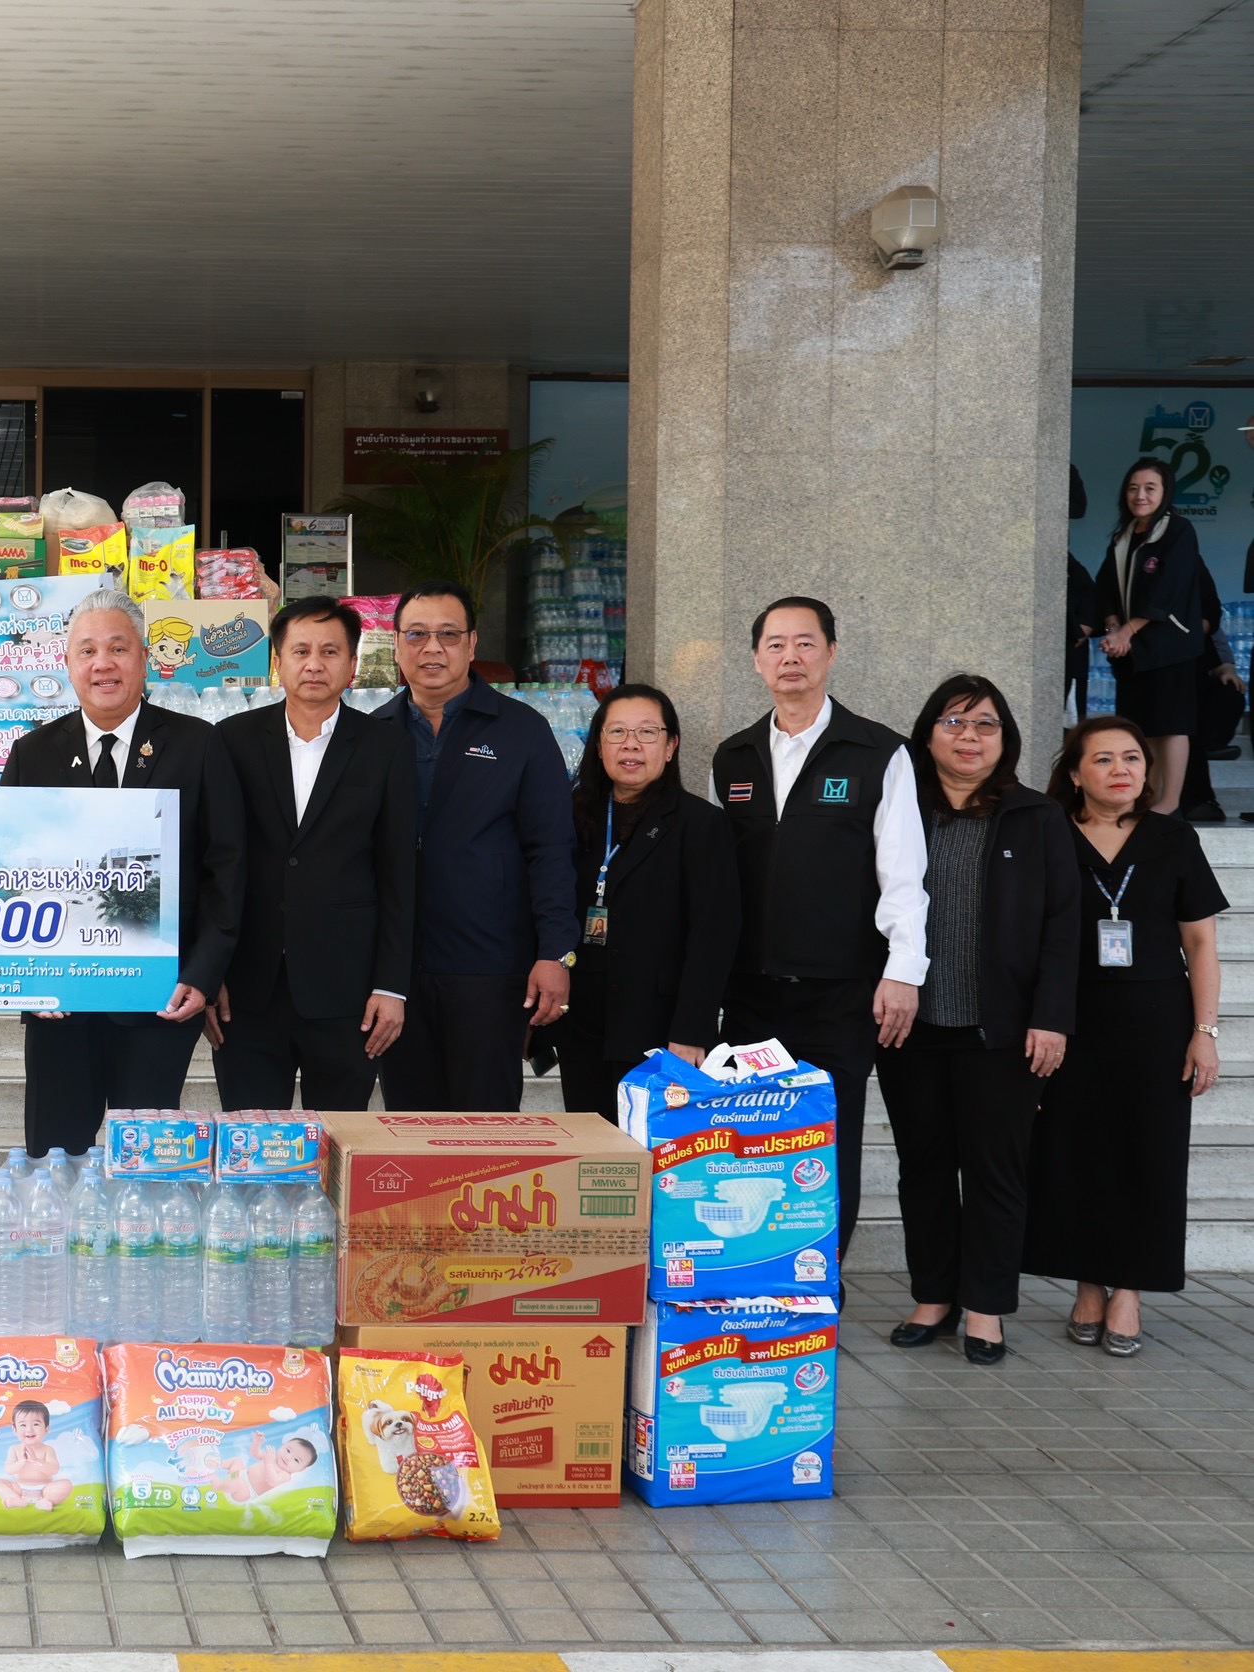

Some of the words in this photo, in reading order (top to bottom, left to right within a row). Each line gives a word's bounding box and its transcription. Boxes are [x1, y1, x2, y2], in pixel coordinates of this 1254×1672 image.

[80, 926, 121, 944] บาท
[68, 963, 142, 979] จังหวัดสงขลา
[761, 1111, 781, 1122] เทป
[198, 1130, 208, 1138] 12
[307, 1132, 317, 1140] 12
[153, 1146, 181, 1157] อันดับ
[183, 1135, 195, 1159] 1
[262, 1148, 290, 1158] อันดับ
[292, 1136, 304, 1160] 1
[657, 1145, 693, 1169] ซุปเปอร์
[694, 1131, 732, 1154] จัมโบ้
[581, 1165, 598, 1176] รหัส
[600, 1166, 637, 1175] 499236
[742, 1160, 784, 1172] แห้งสบาย
[378, 1180, 384, 1189] 5
[386, 1178, 400, 1189] ชั้น
[591, 1178, 626, 1188] MMWG
[449, 1172, 558, 1234] มาม่า
[449, 1268, 503, 1281] รสต้มยำกุ้ง
[505, 1249, 561, 1281] น้ำข้น
[668, 1260, 680, 1272] M
[770, 1318, 787, 1328] เทป
[596, 1347, 606, 1356] ชั้น
[666, 1350, 701, 1374] ซุปเปอร์
[703, 1337, 741, 1359] จัมโบ้
[488, 1345, 562, 1386] มาม่า
[747, 1366, 787, 1377] แห้งสบาย
[155, 1354, 274, 1392] MamyPoko
[20, 1380, 42, 1388] pants
[248, 1386, 269, 1394] pants
[178, 1396, 214, 1406] Happy
[492, 1394, 554, 1415] รสต้มยำกุ้ง
[158, 1406, 176, 1418] All
[178, 1406, 206, 1419] Day
[207, 1406, 232, 1420] Dry
[442, 1414, 462, 1430] MINI
[500, 1444, 543, 1458] ต้นตำรับ
[672, 1464, 683, 1474] M
[138, 1486, 146, 1498] S
[154, 1490, 172, 1500] 78
